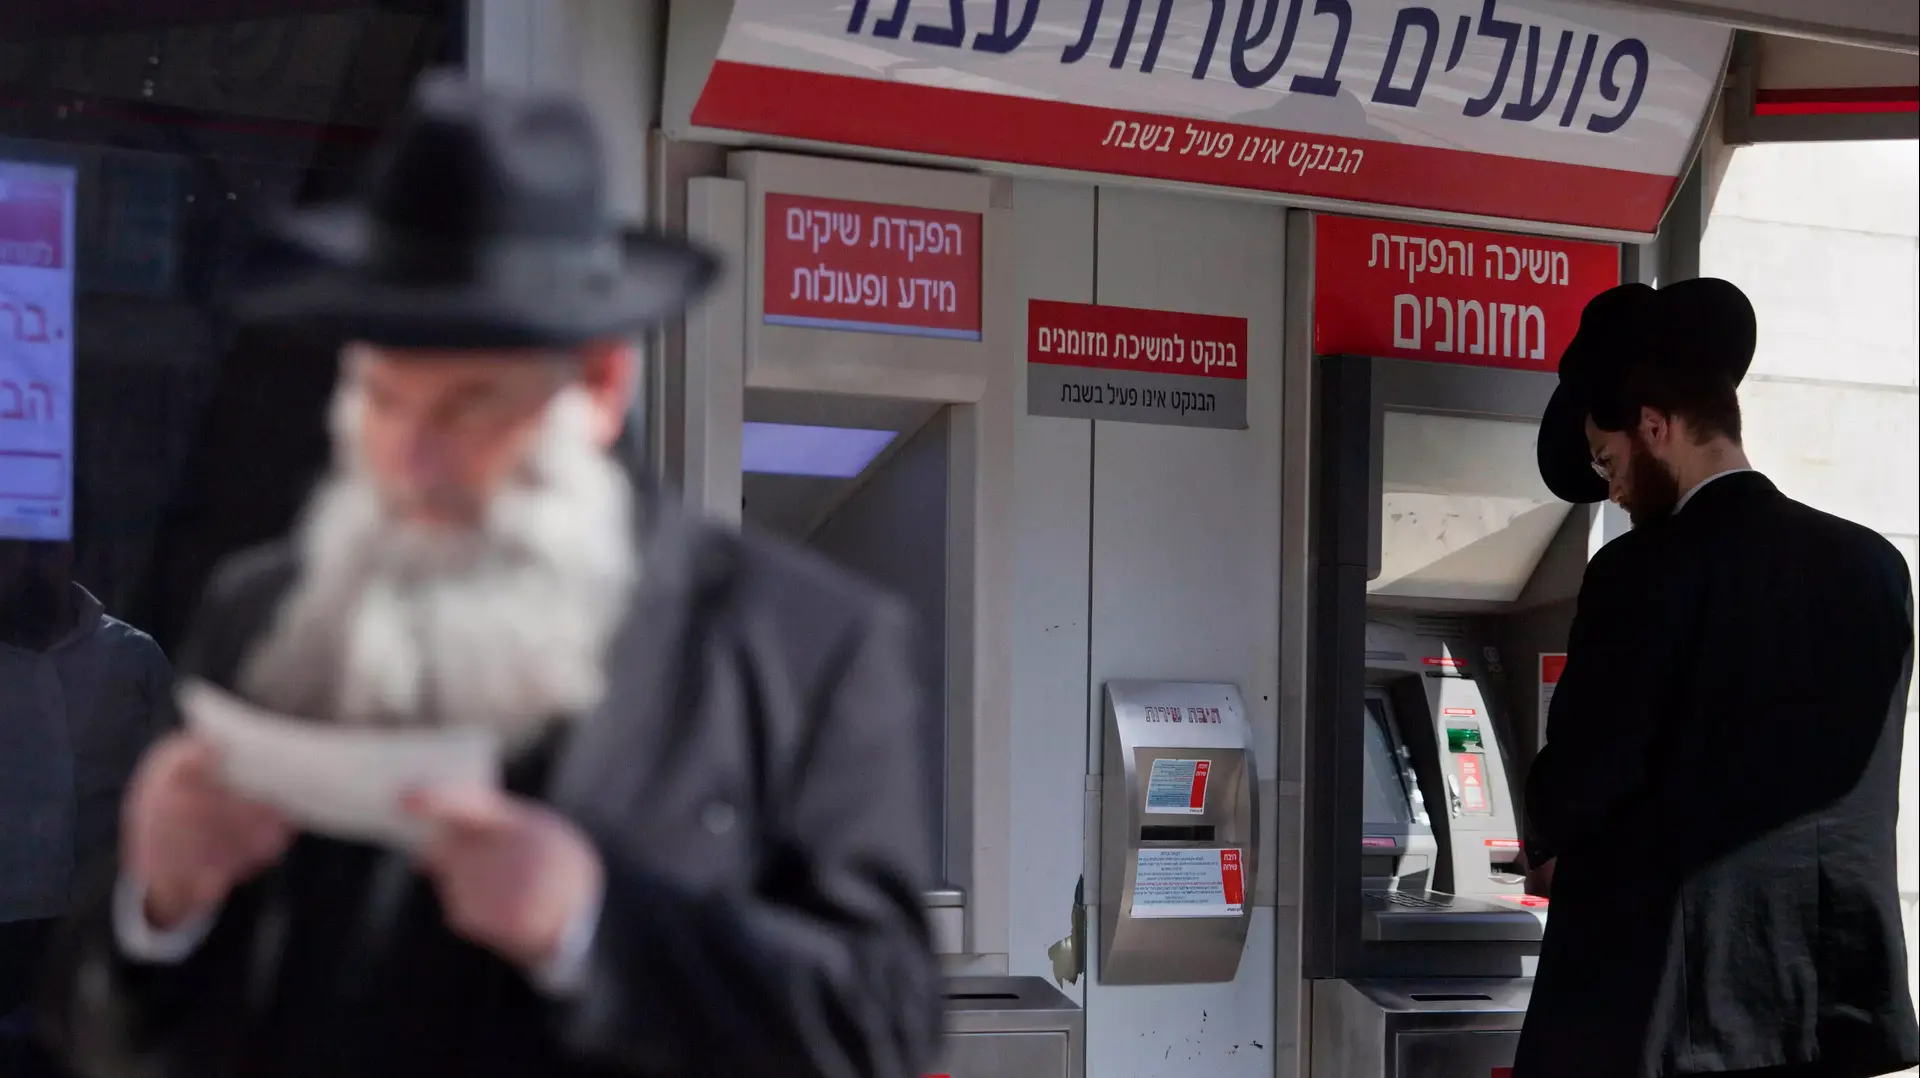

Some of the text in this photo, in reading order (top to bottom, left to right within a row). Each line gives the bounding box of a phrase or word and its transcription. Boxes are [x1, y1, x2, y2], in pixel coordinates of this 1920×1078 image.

[1371, 0, 1650, 134] פועלים
[1101, 120, 1364, 176] הבנקט אינו פעיל בשבת
[786, 207, 962, 263] הפקדת שיקים
[1367, 232, 1569, 286] משיכה והפקדת
[790, 262, 956, 313] מידע ופעולות
[1038, 326, 1238, 373] בנקט למשיכת מזומנים
[1393, 293, 1546, 361] מזומנים
[1061, 383, 1216, 415] הבנקט אינו פעיל בשבת
